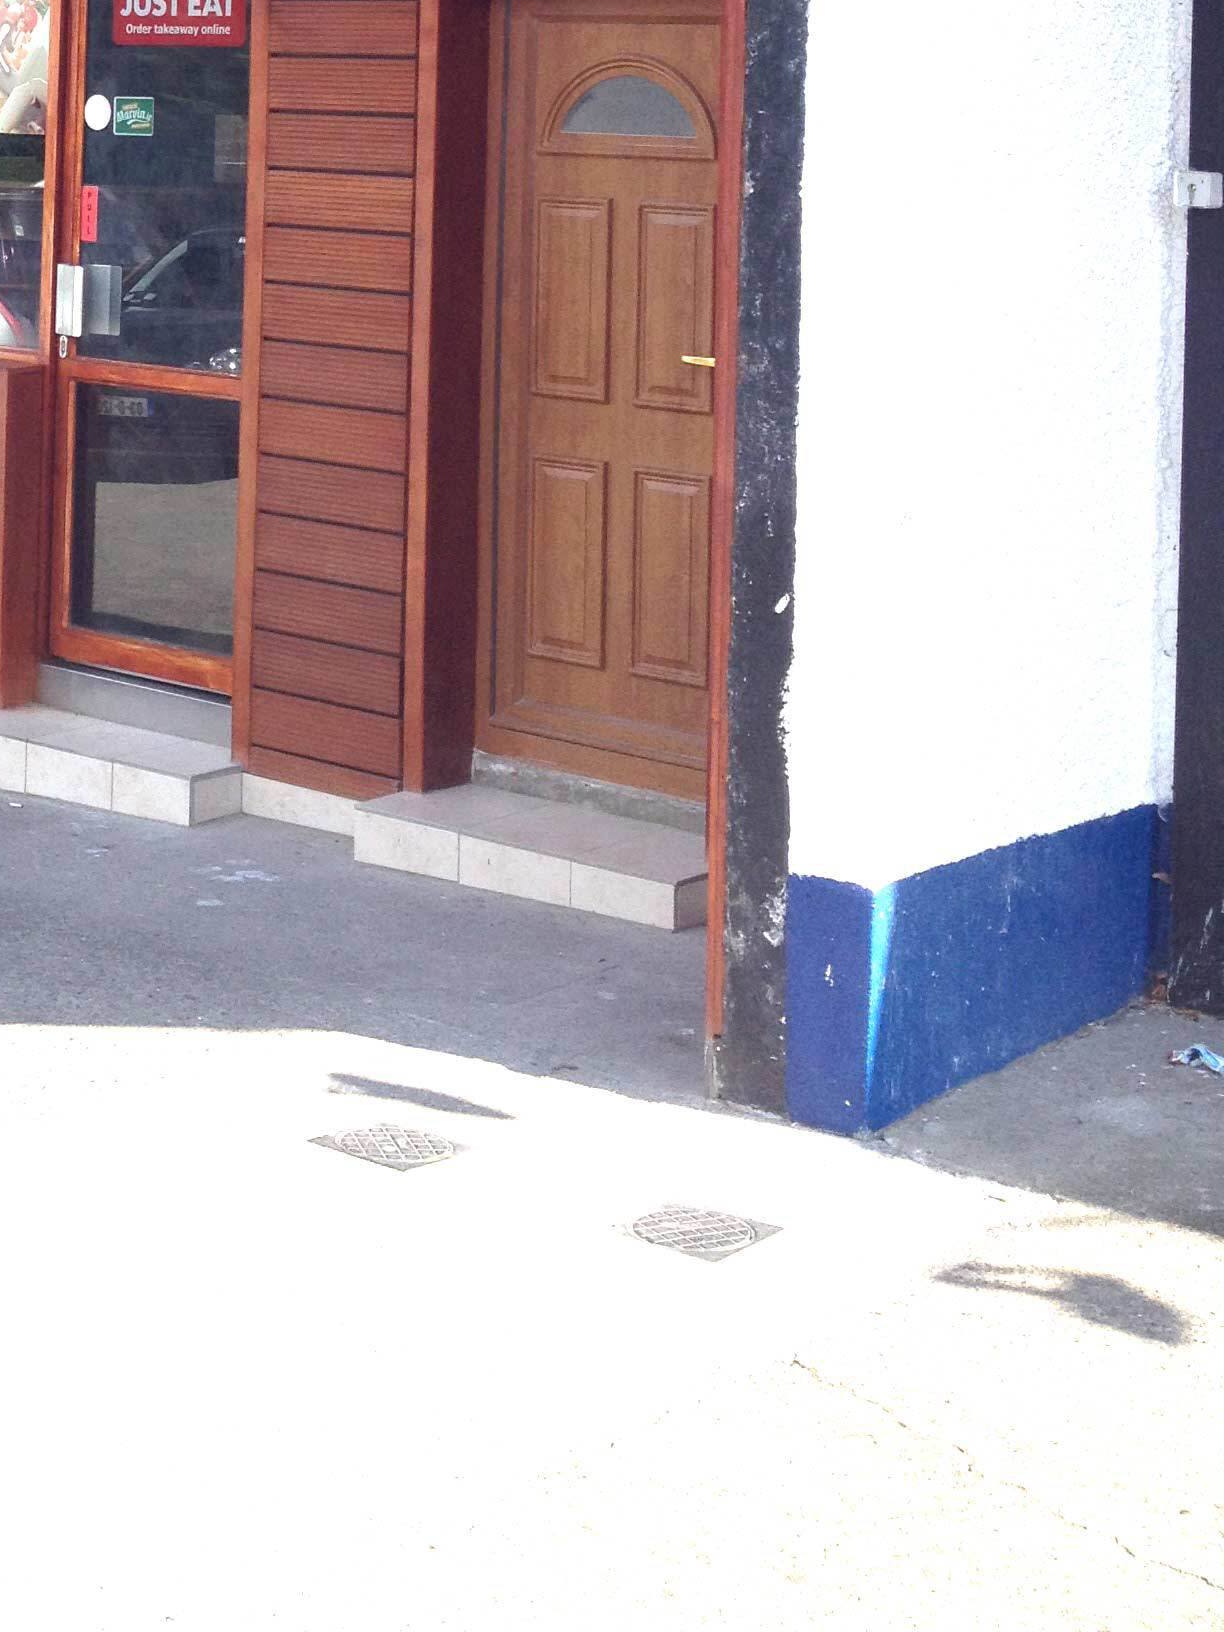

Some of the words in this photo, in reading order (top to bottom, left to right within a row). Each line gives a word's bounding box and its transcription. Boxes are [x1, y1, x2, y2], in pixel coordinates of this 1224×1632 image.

[125, 23, 152, 34] Order
[154, 23, 199, 36] takeaway
[201, 23, 231, 35] online
